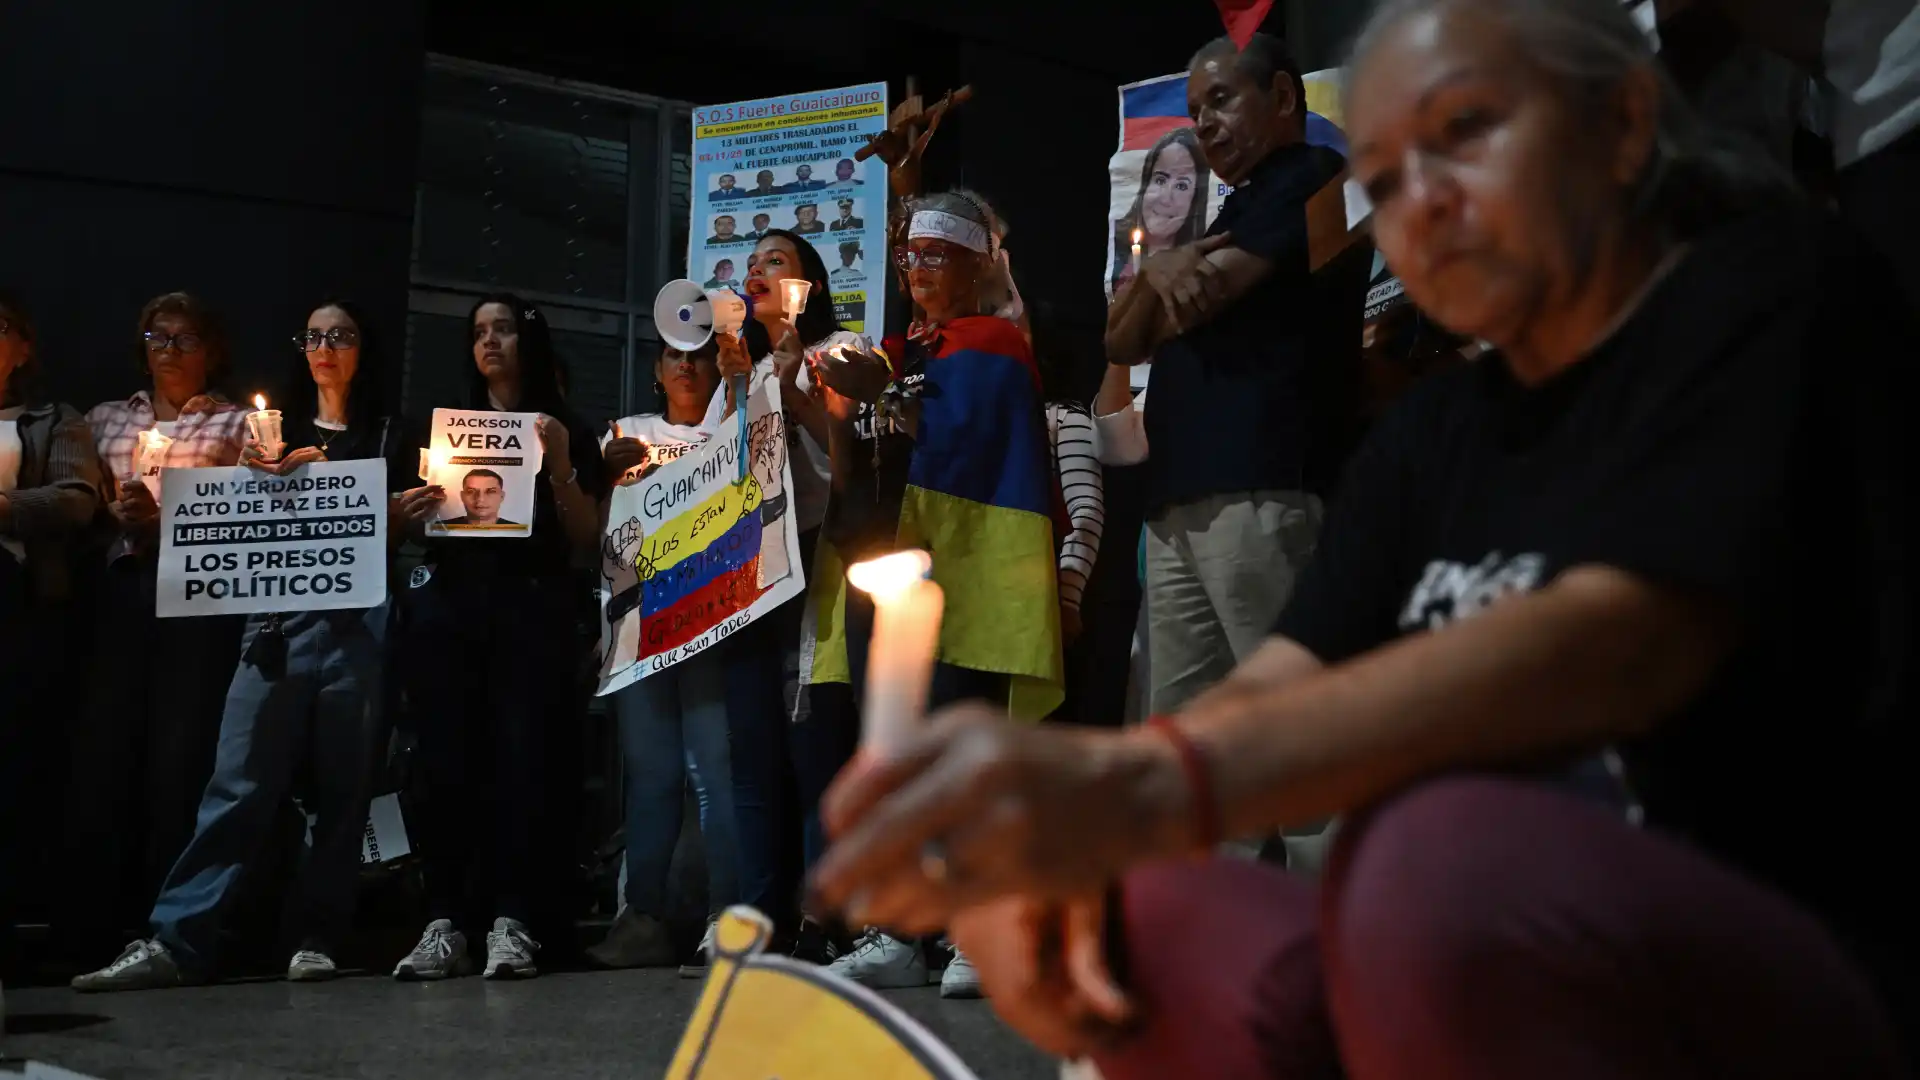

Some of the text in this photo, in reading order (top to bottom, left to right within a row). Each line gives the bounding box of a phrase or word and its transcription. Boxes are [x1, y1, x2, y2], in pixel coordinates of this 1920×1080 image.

[738, 102, 785, 118] Fuerte
[790, 90, 880, 112] Guaicaipuro
[703, 127, 713, 135] Se
[716, 121, 763, 133] encuentran
[777, 113, 829, 126] condiciones
[831, 106, 878, 119] inhumanas
[721, 123, 859, 148] 13 MILITARES TRASLADADOS EL
[733, 149, 842, 171] AL FUERTE GUAICAIPURO
[745, 148, 757, 158] DE
[447, 417, 522, 429] JACKSON
[447, 432, 522, 450] VERA
[196, 475, 356, 497] UN VERDADERO
[175, 494, 370, 517] ACTO DE PAZ ES LA
[176, 518, 373, 542] LIBERTAD DE TODOS
[651, 532, 679, 561] LOS
[185, 546, 355, 573] LOS PRESOS
[185, 571, 353, 601] POLÍTICOS
